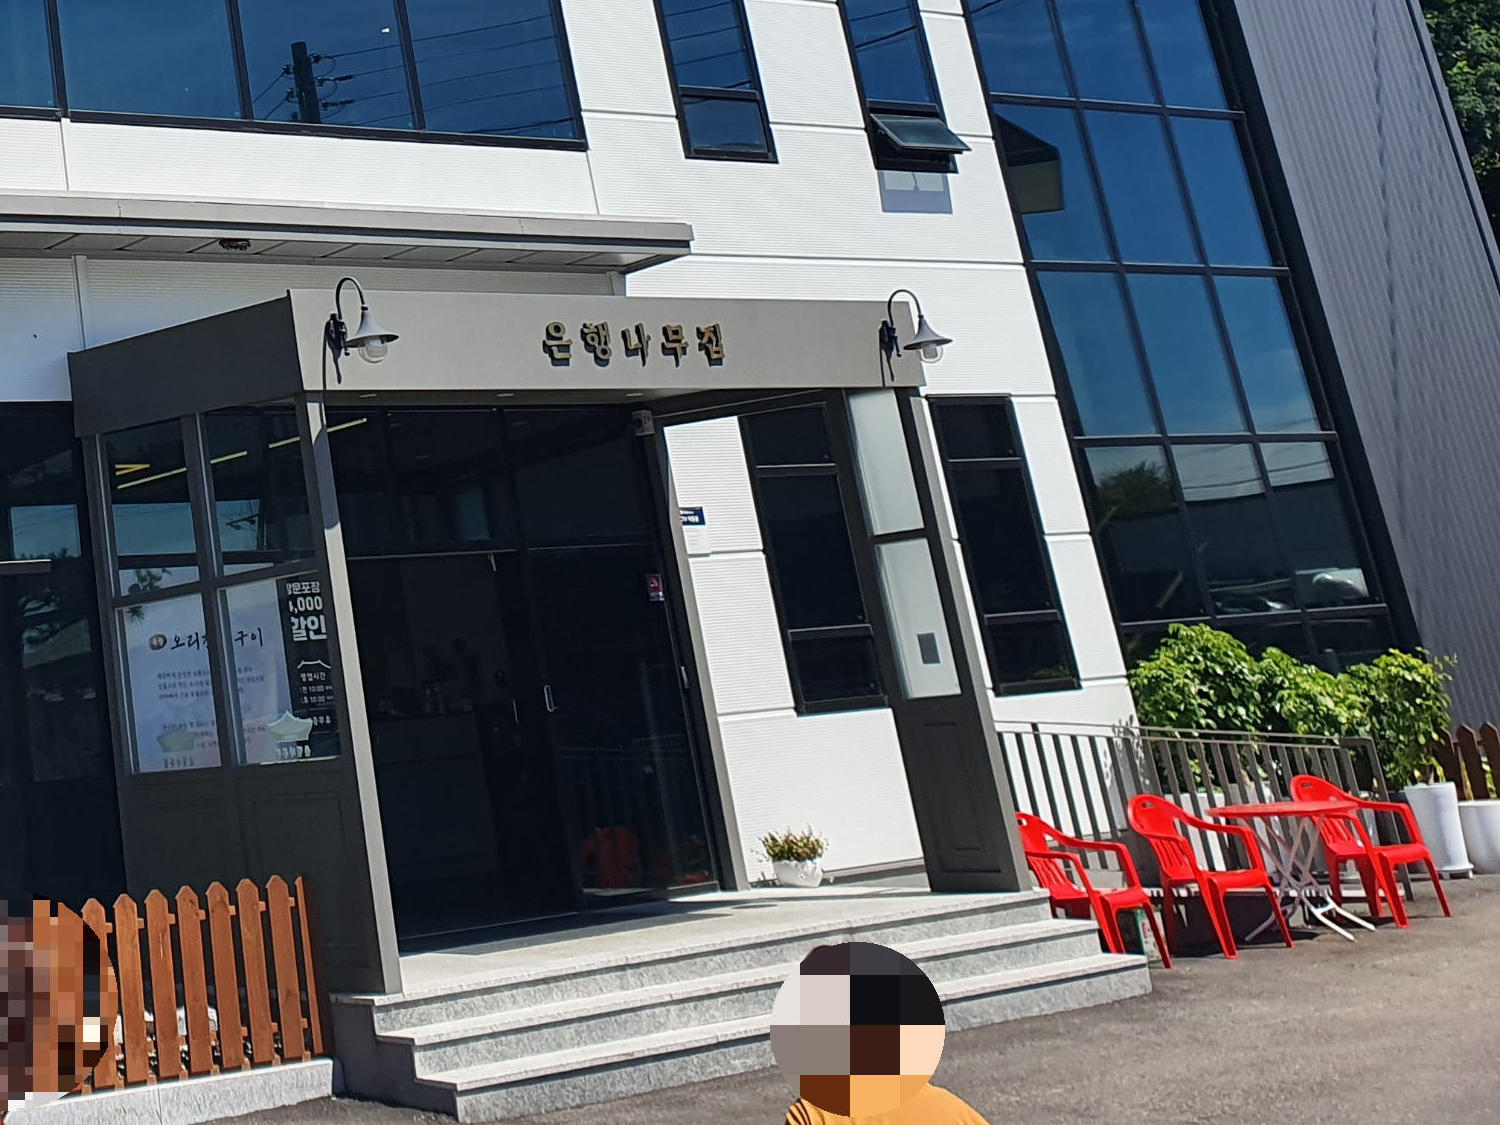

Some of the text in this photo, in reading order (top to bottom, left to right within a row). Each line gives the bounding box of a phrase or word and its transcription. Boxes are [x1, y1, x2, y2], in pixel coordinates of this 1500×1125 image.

[543, 321, 726, 364] 은행나무집
[309, 684, 325, 693] 10:00
[310, 695, 326, 703] 10:00
